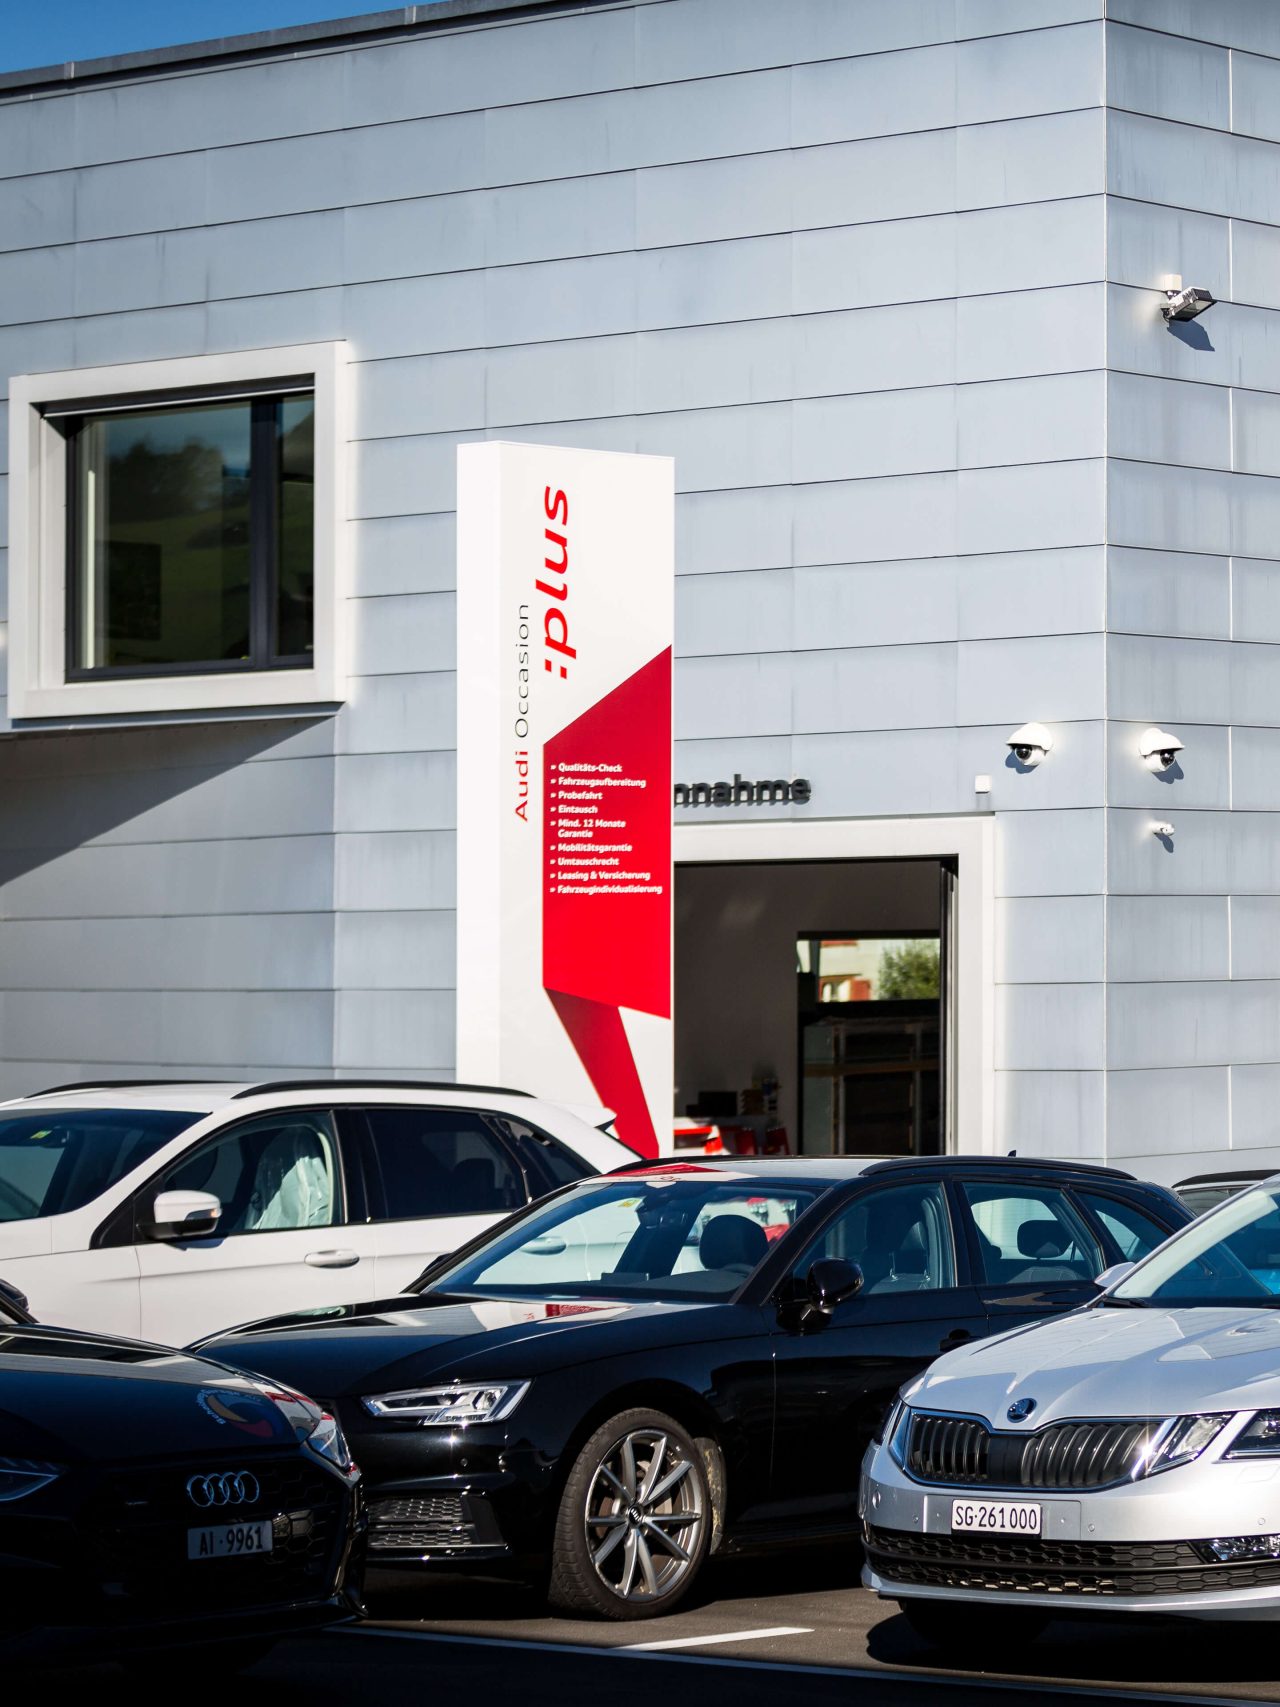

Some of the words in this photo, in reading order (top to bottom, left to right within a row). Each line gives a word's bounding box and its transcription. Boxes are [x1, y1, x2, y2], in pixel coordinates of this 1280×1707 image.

[514, 604, 529, 738] Occasion
[558, 763, 623, 773] Qualitäts-Check
[515, 750, 529, 822] Audi
[558, 777, 647, 788] Fahrzeugaufbereitung
[558, 791, 603, 800] Probefahrt
[558, 805, 598, 814] Eintausch
[558, 819, 581, 828] Mind.
[583, 819, 594, 828] 12
[595, 819, 626, 828] Monate
[558, 829, 593, 838] Garantie
[558, 843, 633, 853] Mobilitätsgarantie
[558, 857, 619, 866] Umtauschrecht
[558, 871, 589, 881] Leasing
[590, 871, 597, 880] &
[598, 871, 651, 881] Versicherung
[557, 885, 663, 895] Fahrzeugindividualisierung
